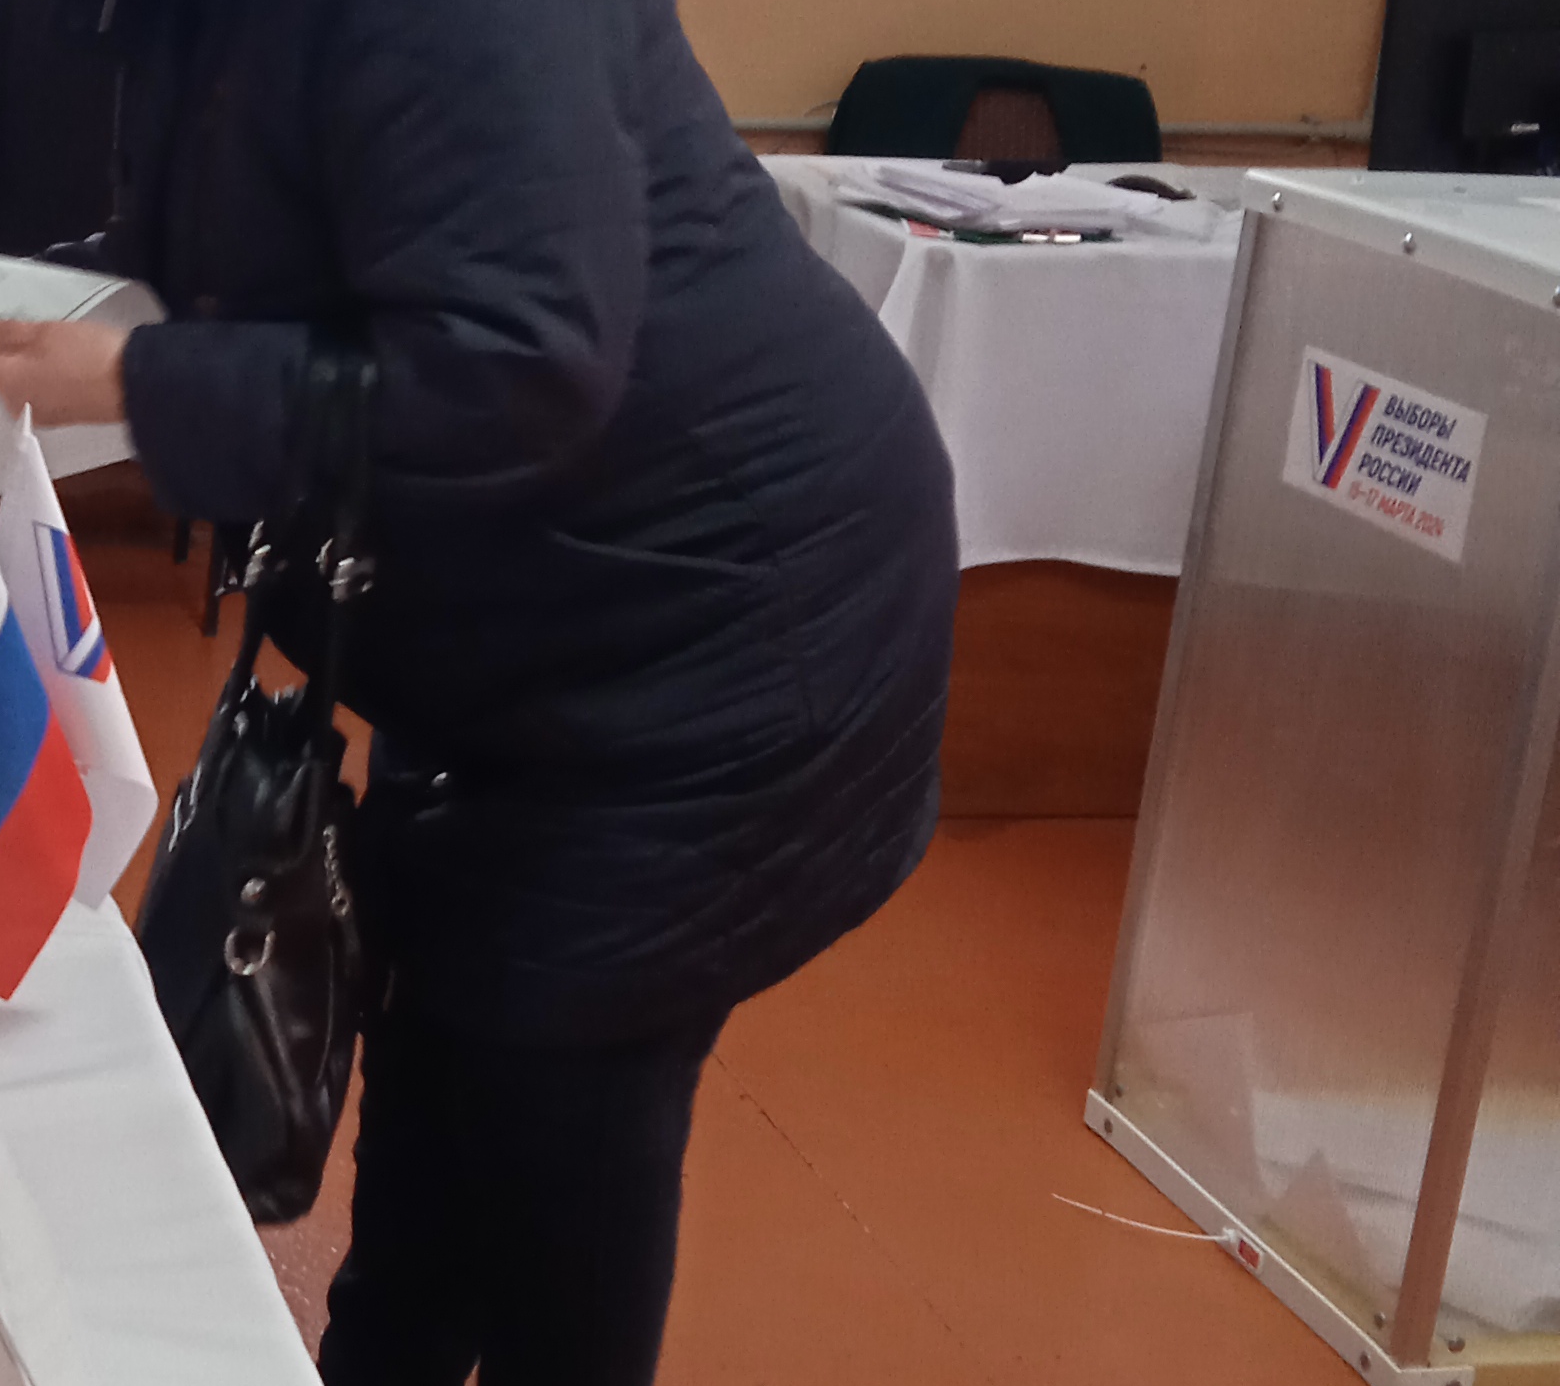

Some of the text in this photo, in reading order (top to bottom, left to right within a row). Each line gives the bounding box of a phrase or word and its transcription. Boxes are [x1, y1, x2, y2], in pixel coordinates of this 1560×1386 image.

[1383, 394, 1458, 440] ВЫБОРЫ
[1357, 453, 1423, 497] РОССИИ
[1370, 423, 1473, 483] ПРЕЗИДЕНТА
[1377, 494, 1417, 523] МАРТА
